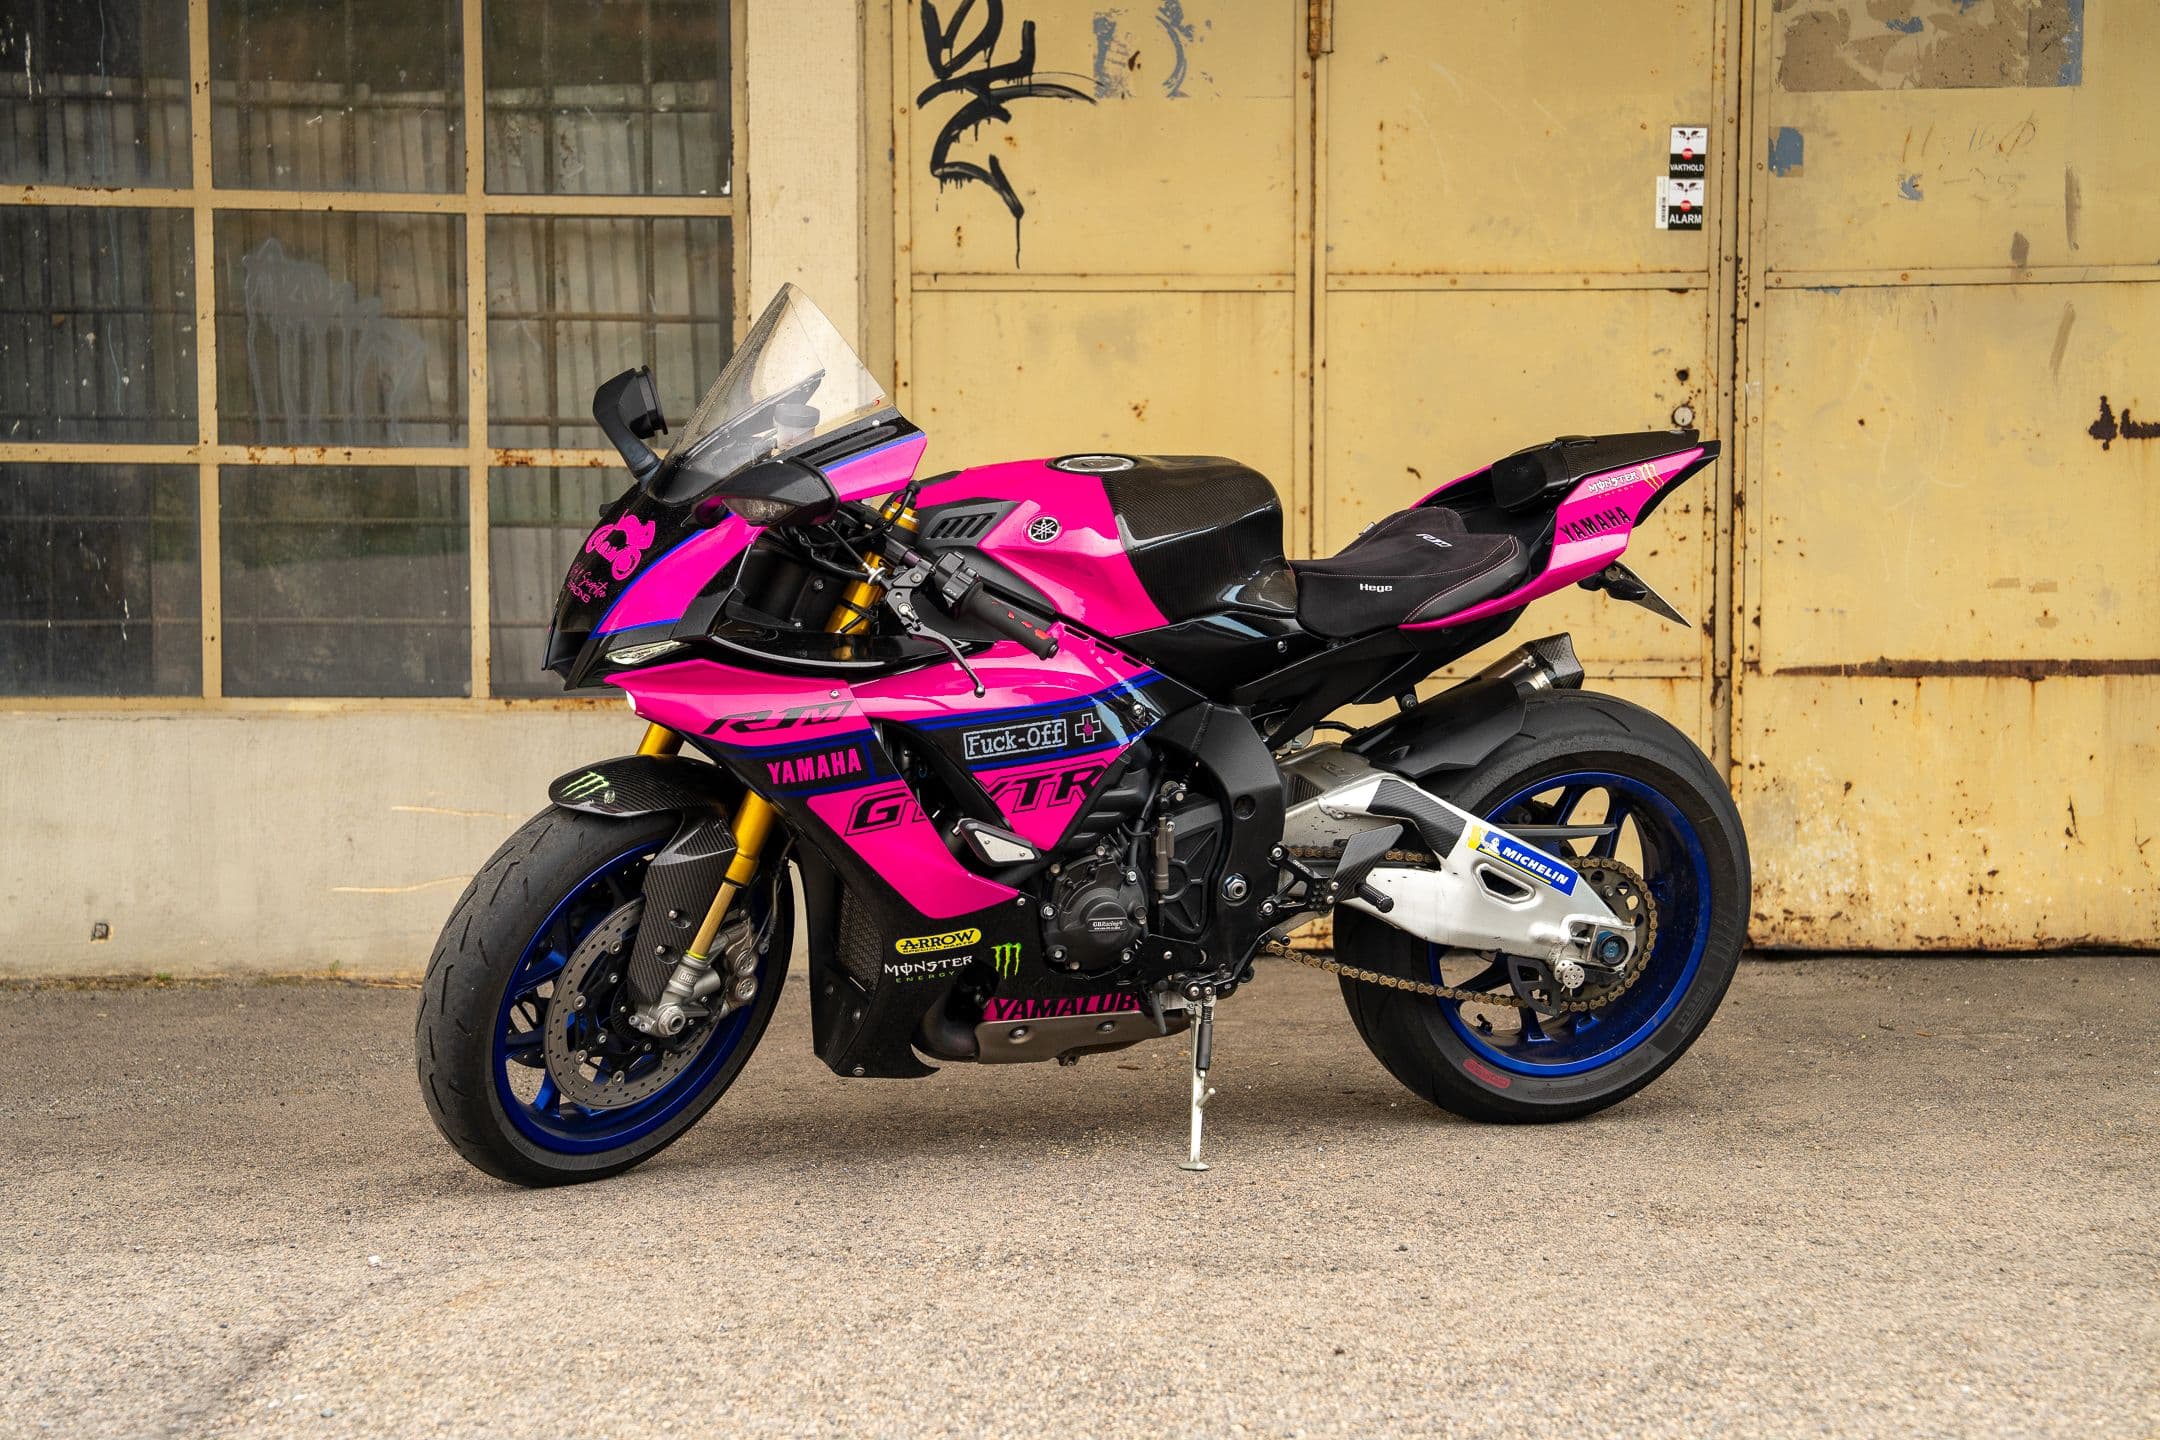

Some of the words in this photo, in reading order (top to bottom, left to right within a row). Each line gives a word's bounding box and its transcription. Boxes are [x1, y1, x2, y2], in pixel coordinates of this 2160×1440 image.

[1670, 163, 1704, 172] VAKTHOLD
[1669, 213, 1702, 224] ALARM
[1588, 471, 1639, 493] MONSTER
[1559, 506, 1632, 543] YAMAHA
[1360, 583, 1393, 593] Hege
[967, 720, 1064, 757] Fuck-Off
[767, 748, 862, 785] YAMAHA
[1502, 846, 1569, 885] MICHELIN
[900, 930, 975, 950] ARROW
[884, 955, 973, 977] MONSTER
[895, 970, 957, 984] ENERGY
